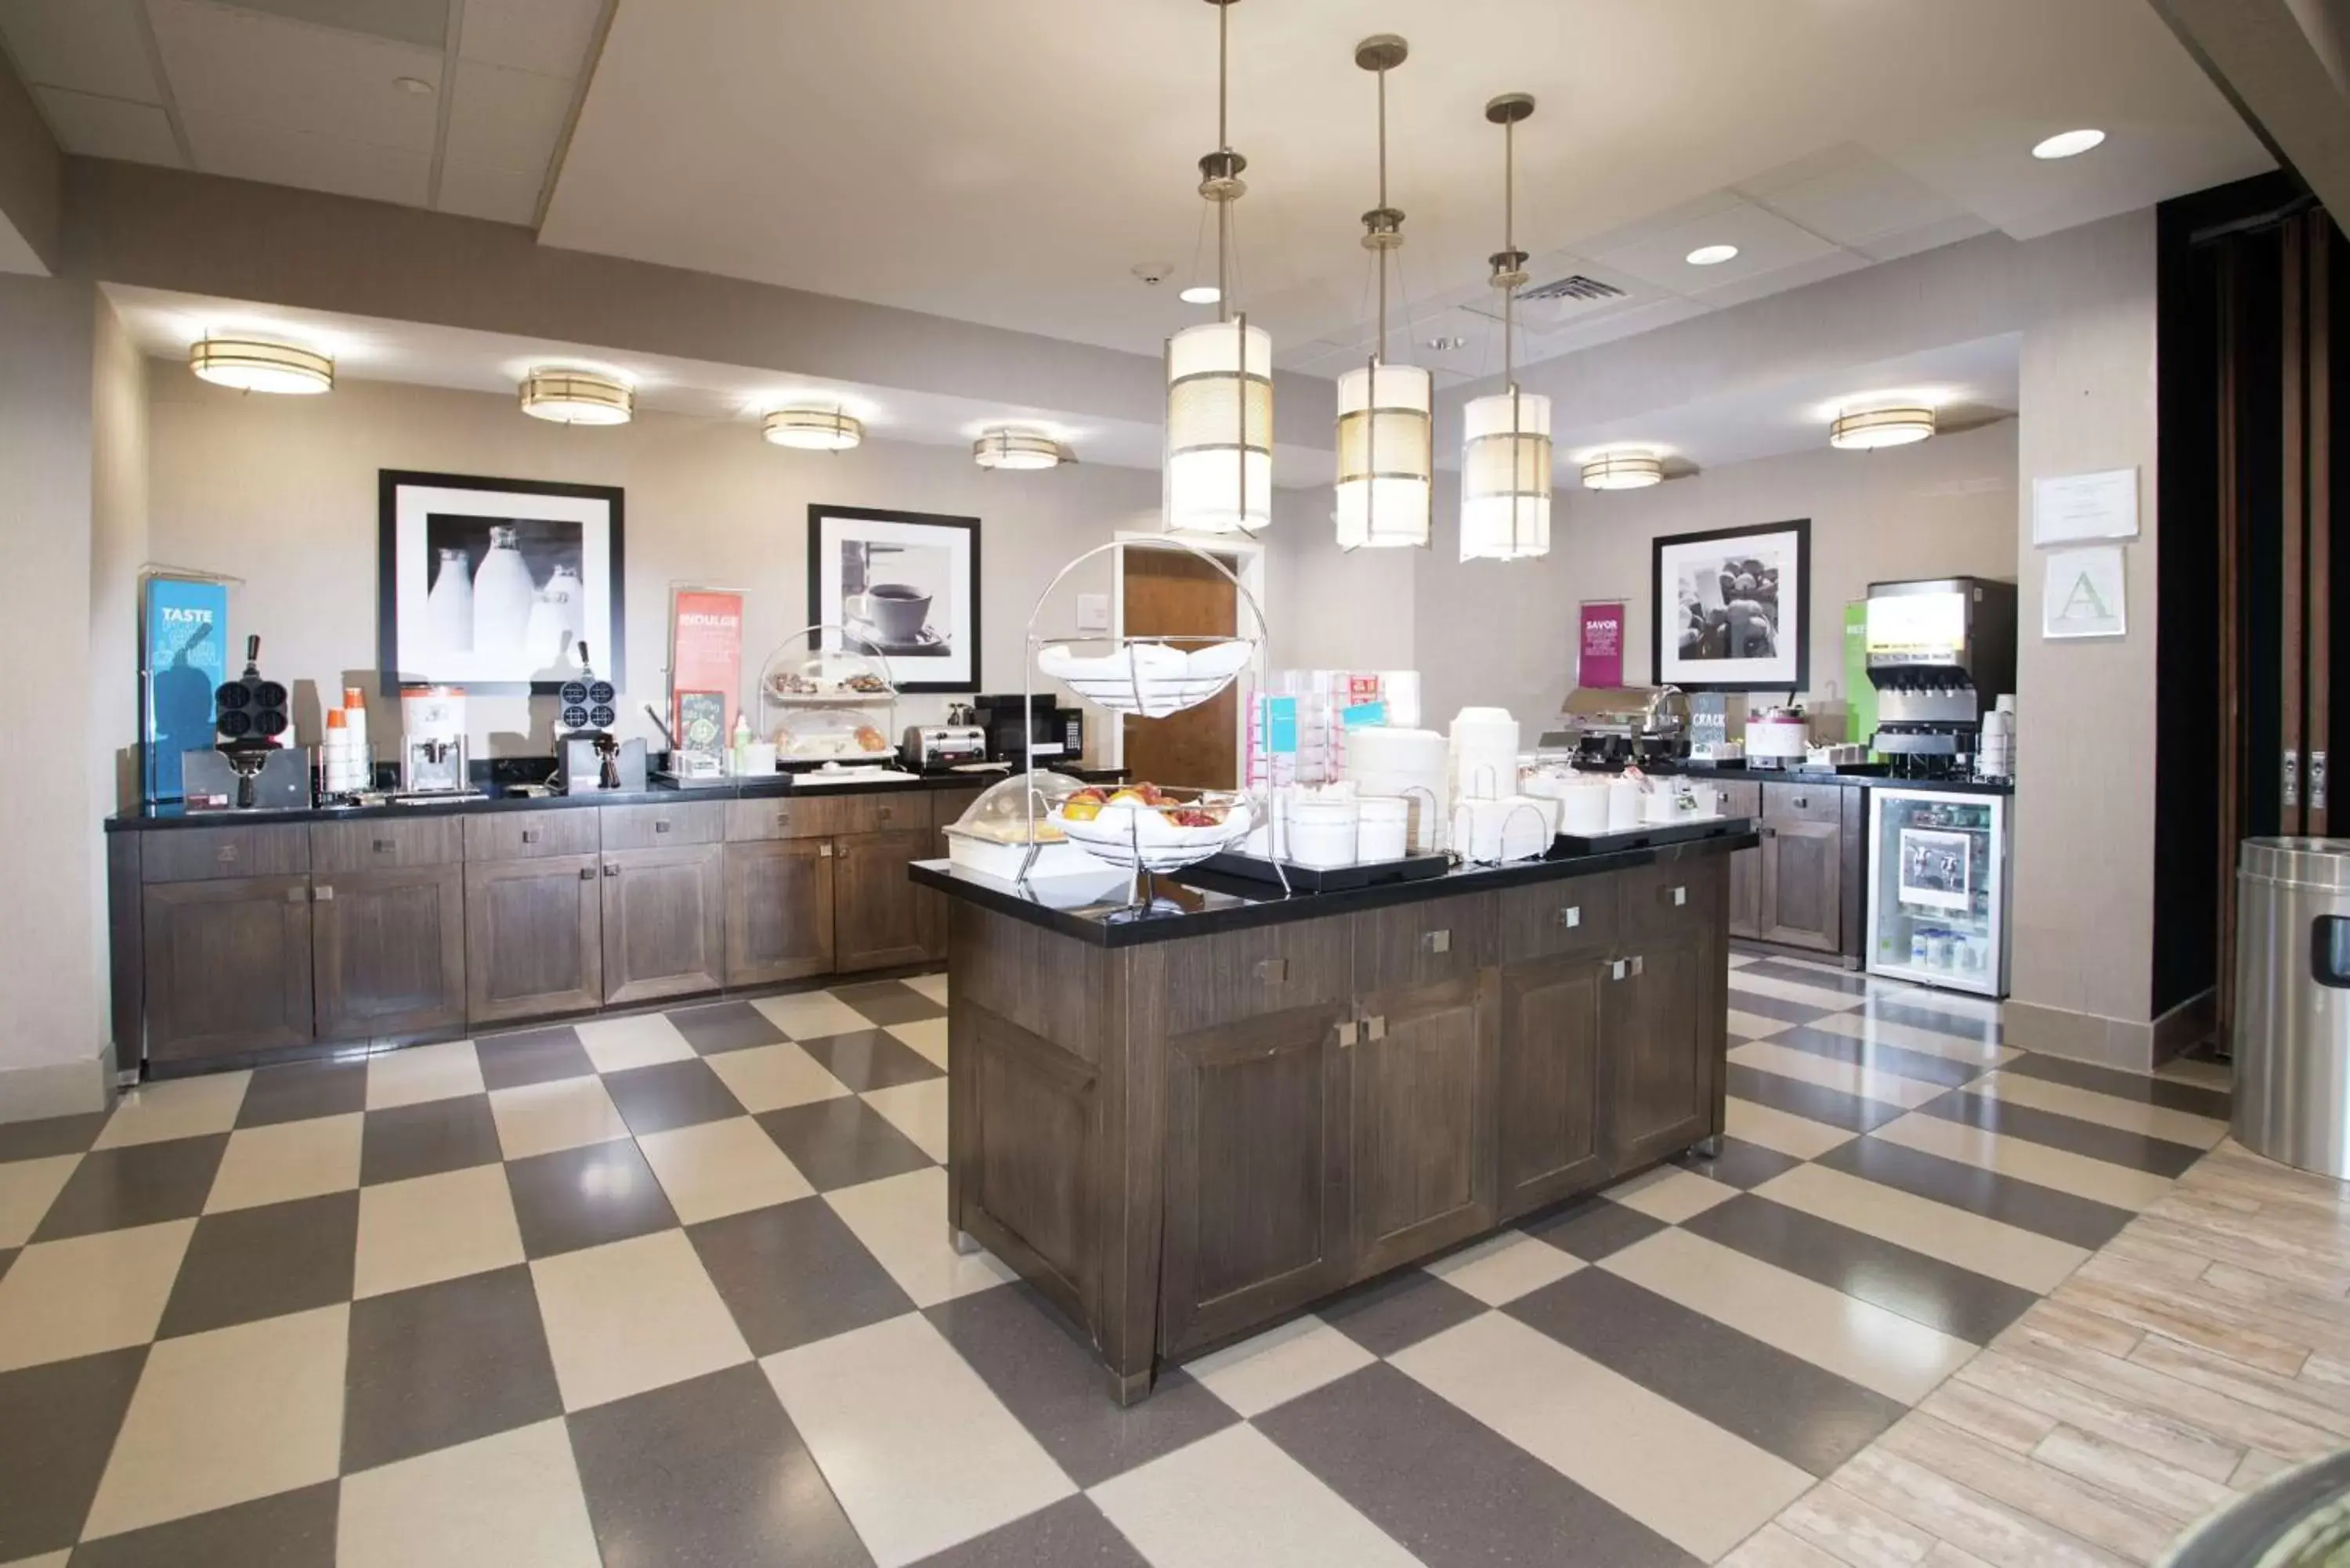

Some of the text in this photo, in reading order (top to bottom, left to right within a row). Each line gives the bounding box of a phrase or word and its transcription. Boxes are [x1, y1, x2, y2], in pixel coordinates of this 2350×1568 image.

[2055, 570, 2118, 620] A
[162, 607, 213, 623] TASTE
[678, 613, 739, 627] INDULGE
[1586, 620, 1618, 630] SAVOR
